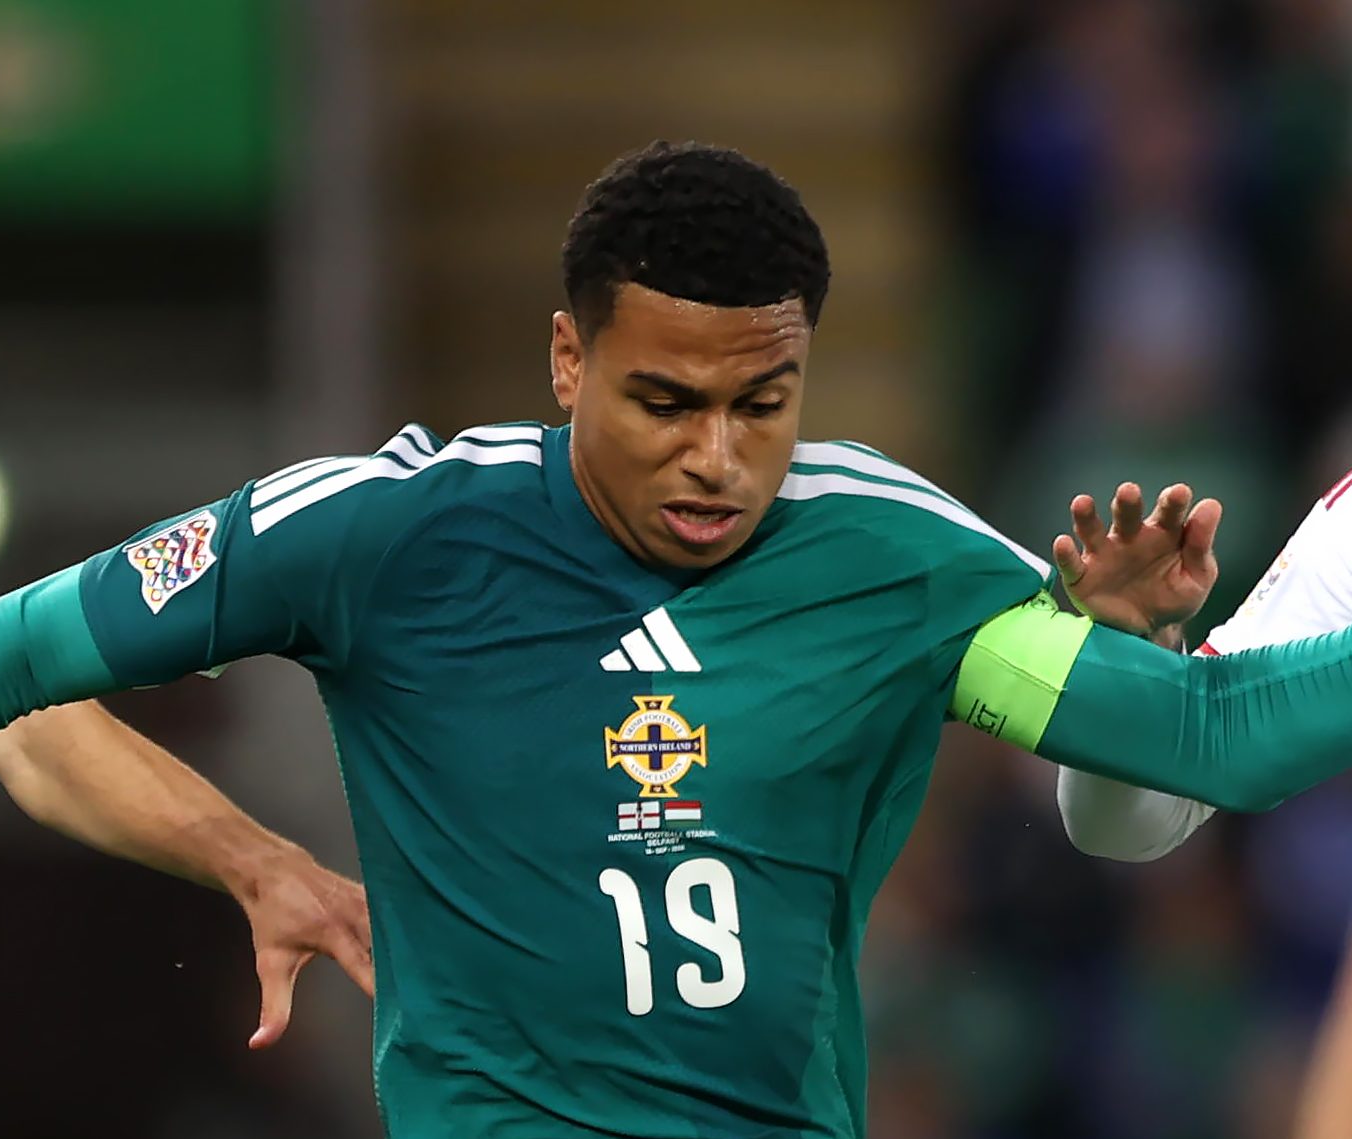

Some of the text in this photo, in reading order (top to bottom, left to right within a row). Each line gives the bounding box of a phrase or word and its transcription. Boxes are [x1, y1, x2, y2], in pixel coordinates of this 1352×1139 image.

[619, 742, 692, 752] NORTHERN IRELAND
[607, 832, 644, 843] NATIONAL
[644, 830, 684, 840] FOOTBALL
[646, 838, 681, 848] BELFAST
[598, 857, 747, 1016] 19
